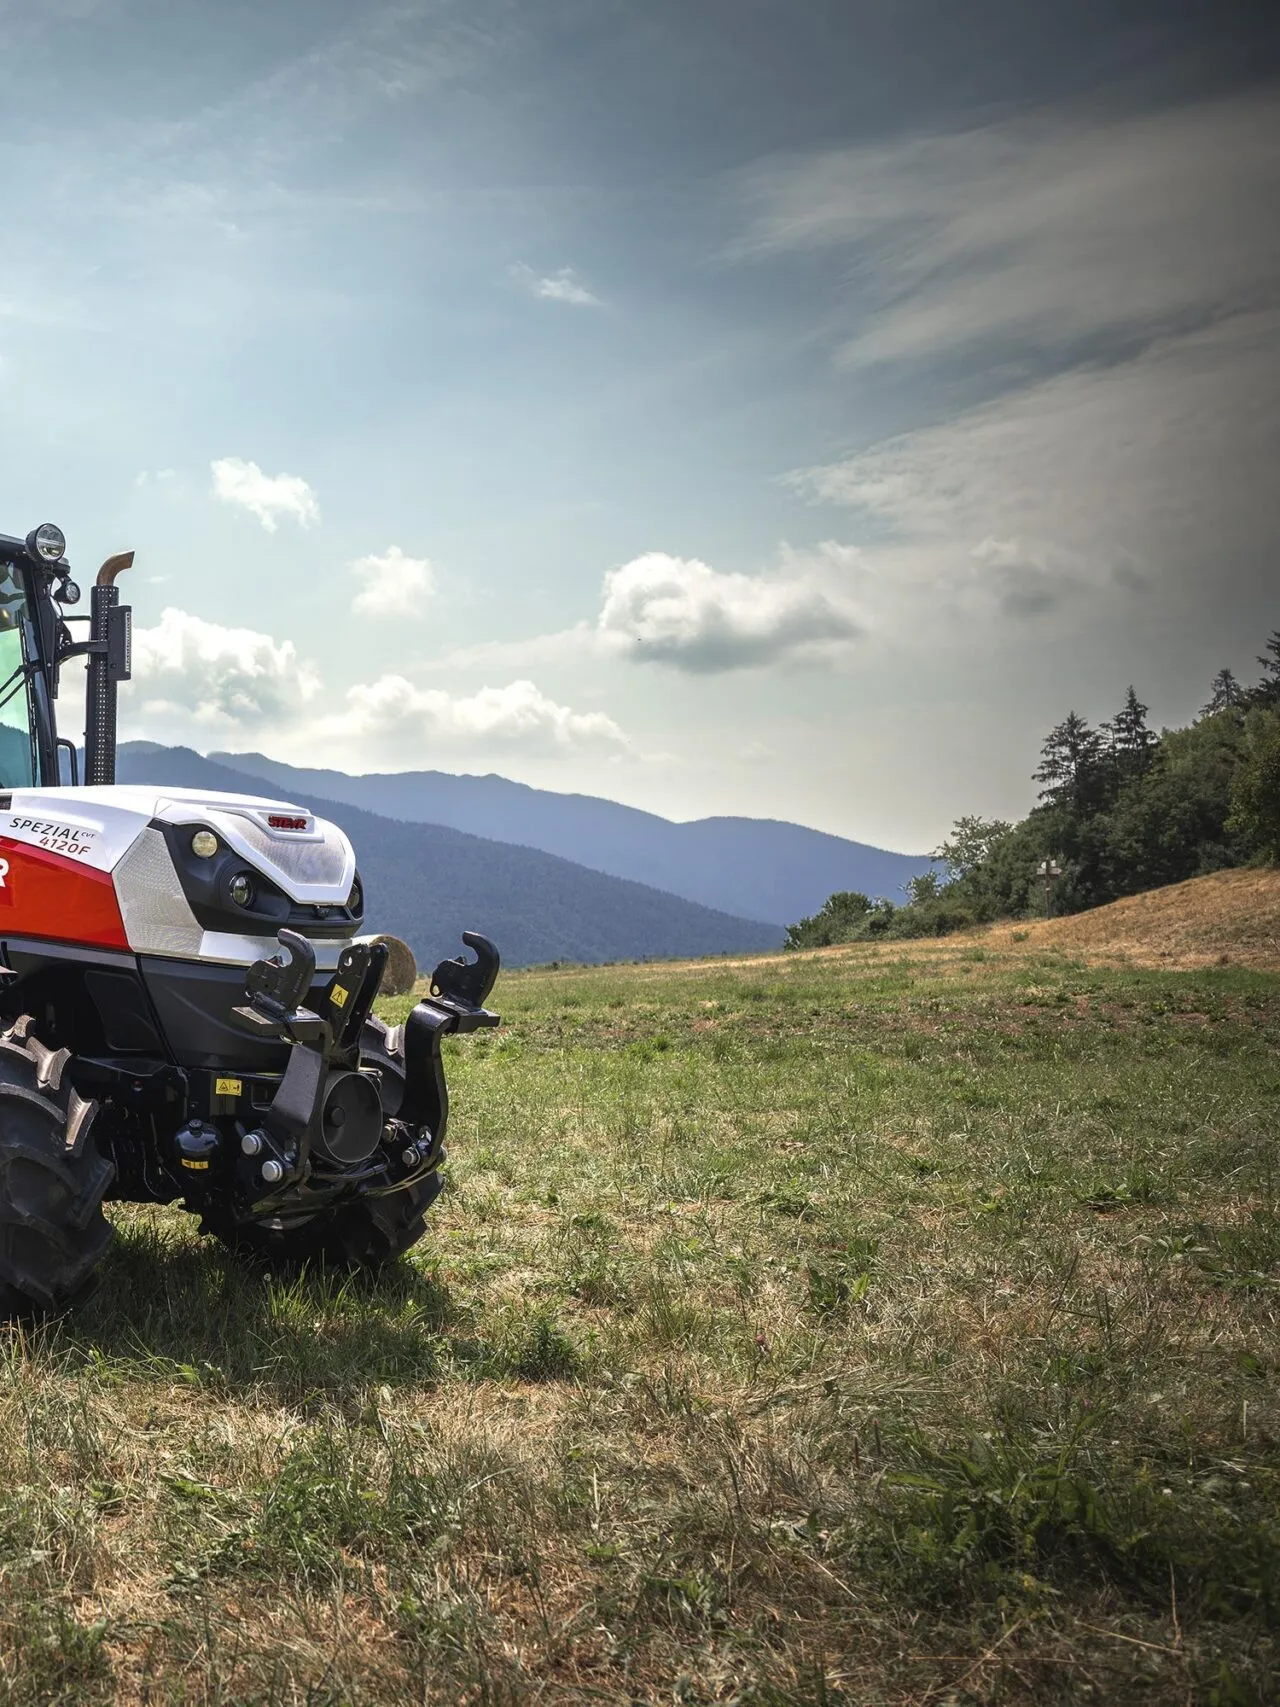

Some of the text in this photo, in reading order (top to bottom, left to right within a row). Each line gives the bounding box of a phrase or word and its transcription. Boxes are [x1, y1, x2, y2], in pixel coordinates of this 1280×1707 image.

[9, 817, 80, 841] SPEZIAL
[268, 815, 307, 829] STEYR
[39, 836, 91, 855] 4120F
